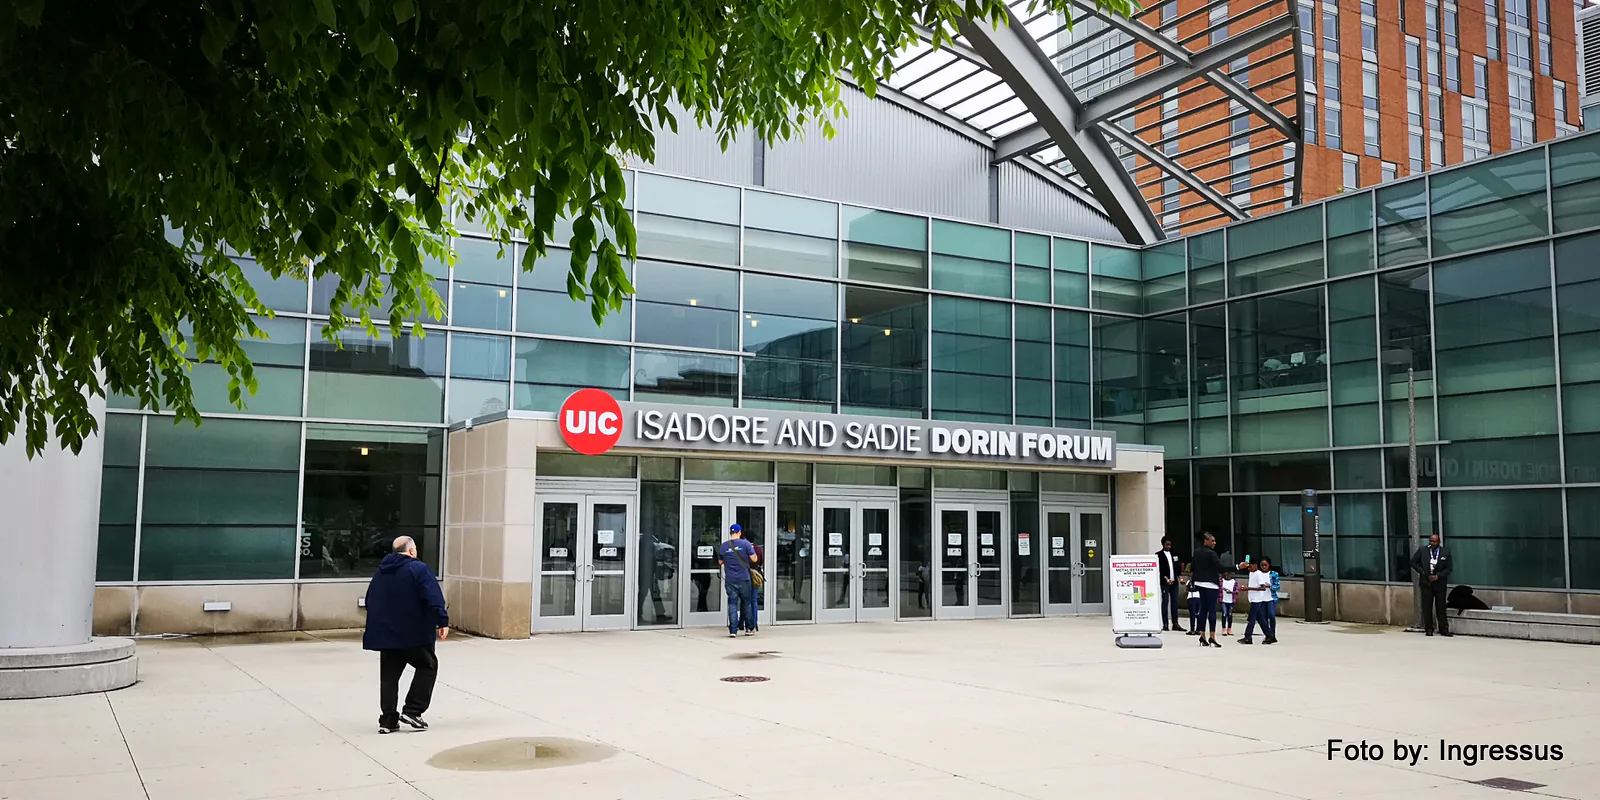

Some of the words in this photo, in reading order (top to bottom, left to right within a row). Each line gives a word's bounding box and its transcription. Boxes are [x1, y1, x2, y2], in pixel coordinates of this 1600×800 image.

[566, 410, 619, 435] UIC
[635, 410, 770, 444] ISADORE
[777, 418, 838, 448] AND
[846, 422, 922, 452] SADIE
[931, 427, 1018, 457] DORIN
[1022, 431, 1113, 461] FORUM
